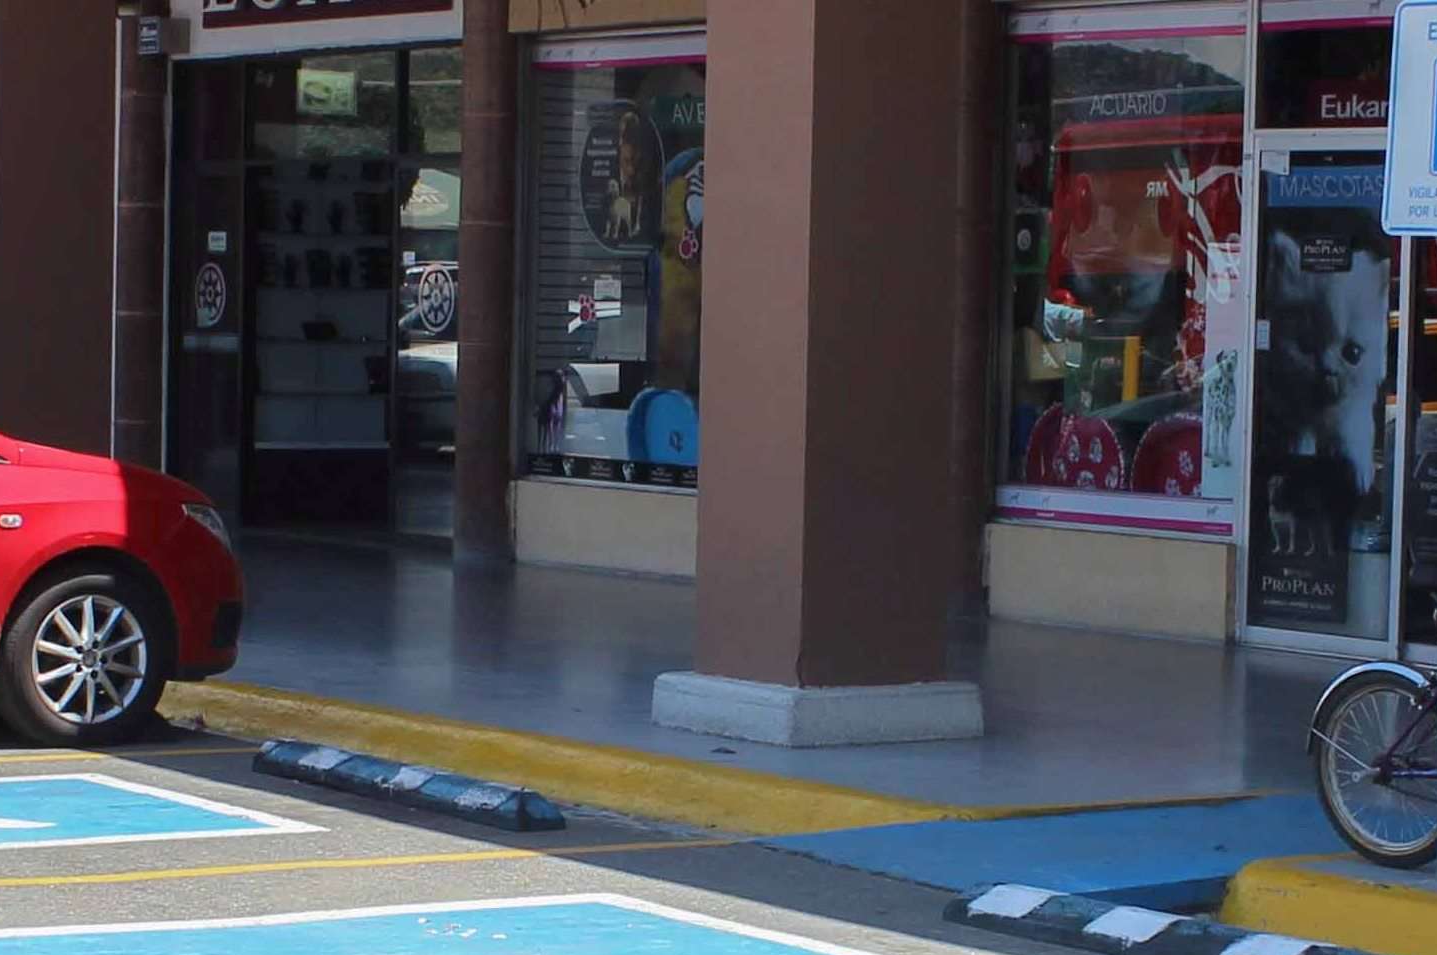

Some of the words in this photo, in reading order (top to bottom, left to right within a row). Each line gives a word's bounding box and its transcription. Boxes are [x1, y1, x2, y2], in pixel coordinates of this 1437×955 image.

[1090, 92, 1167, 116] ACUARIO
[1280, 175, 1384, 197] MASCOTAS
[1409, 205, 1429, 217] POR
